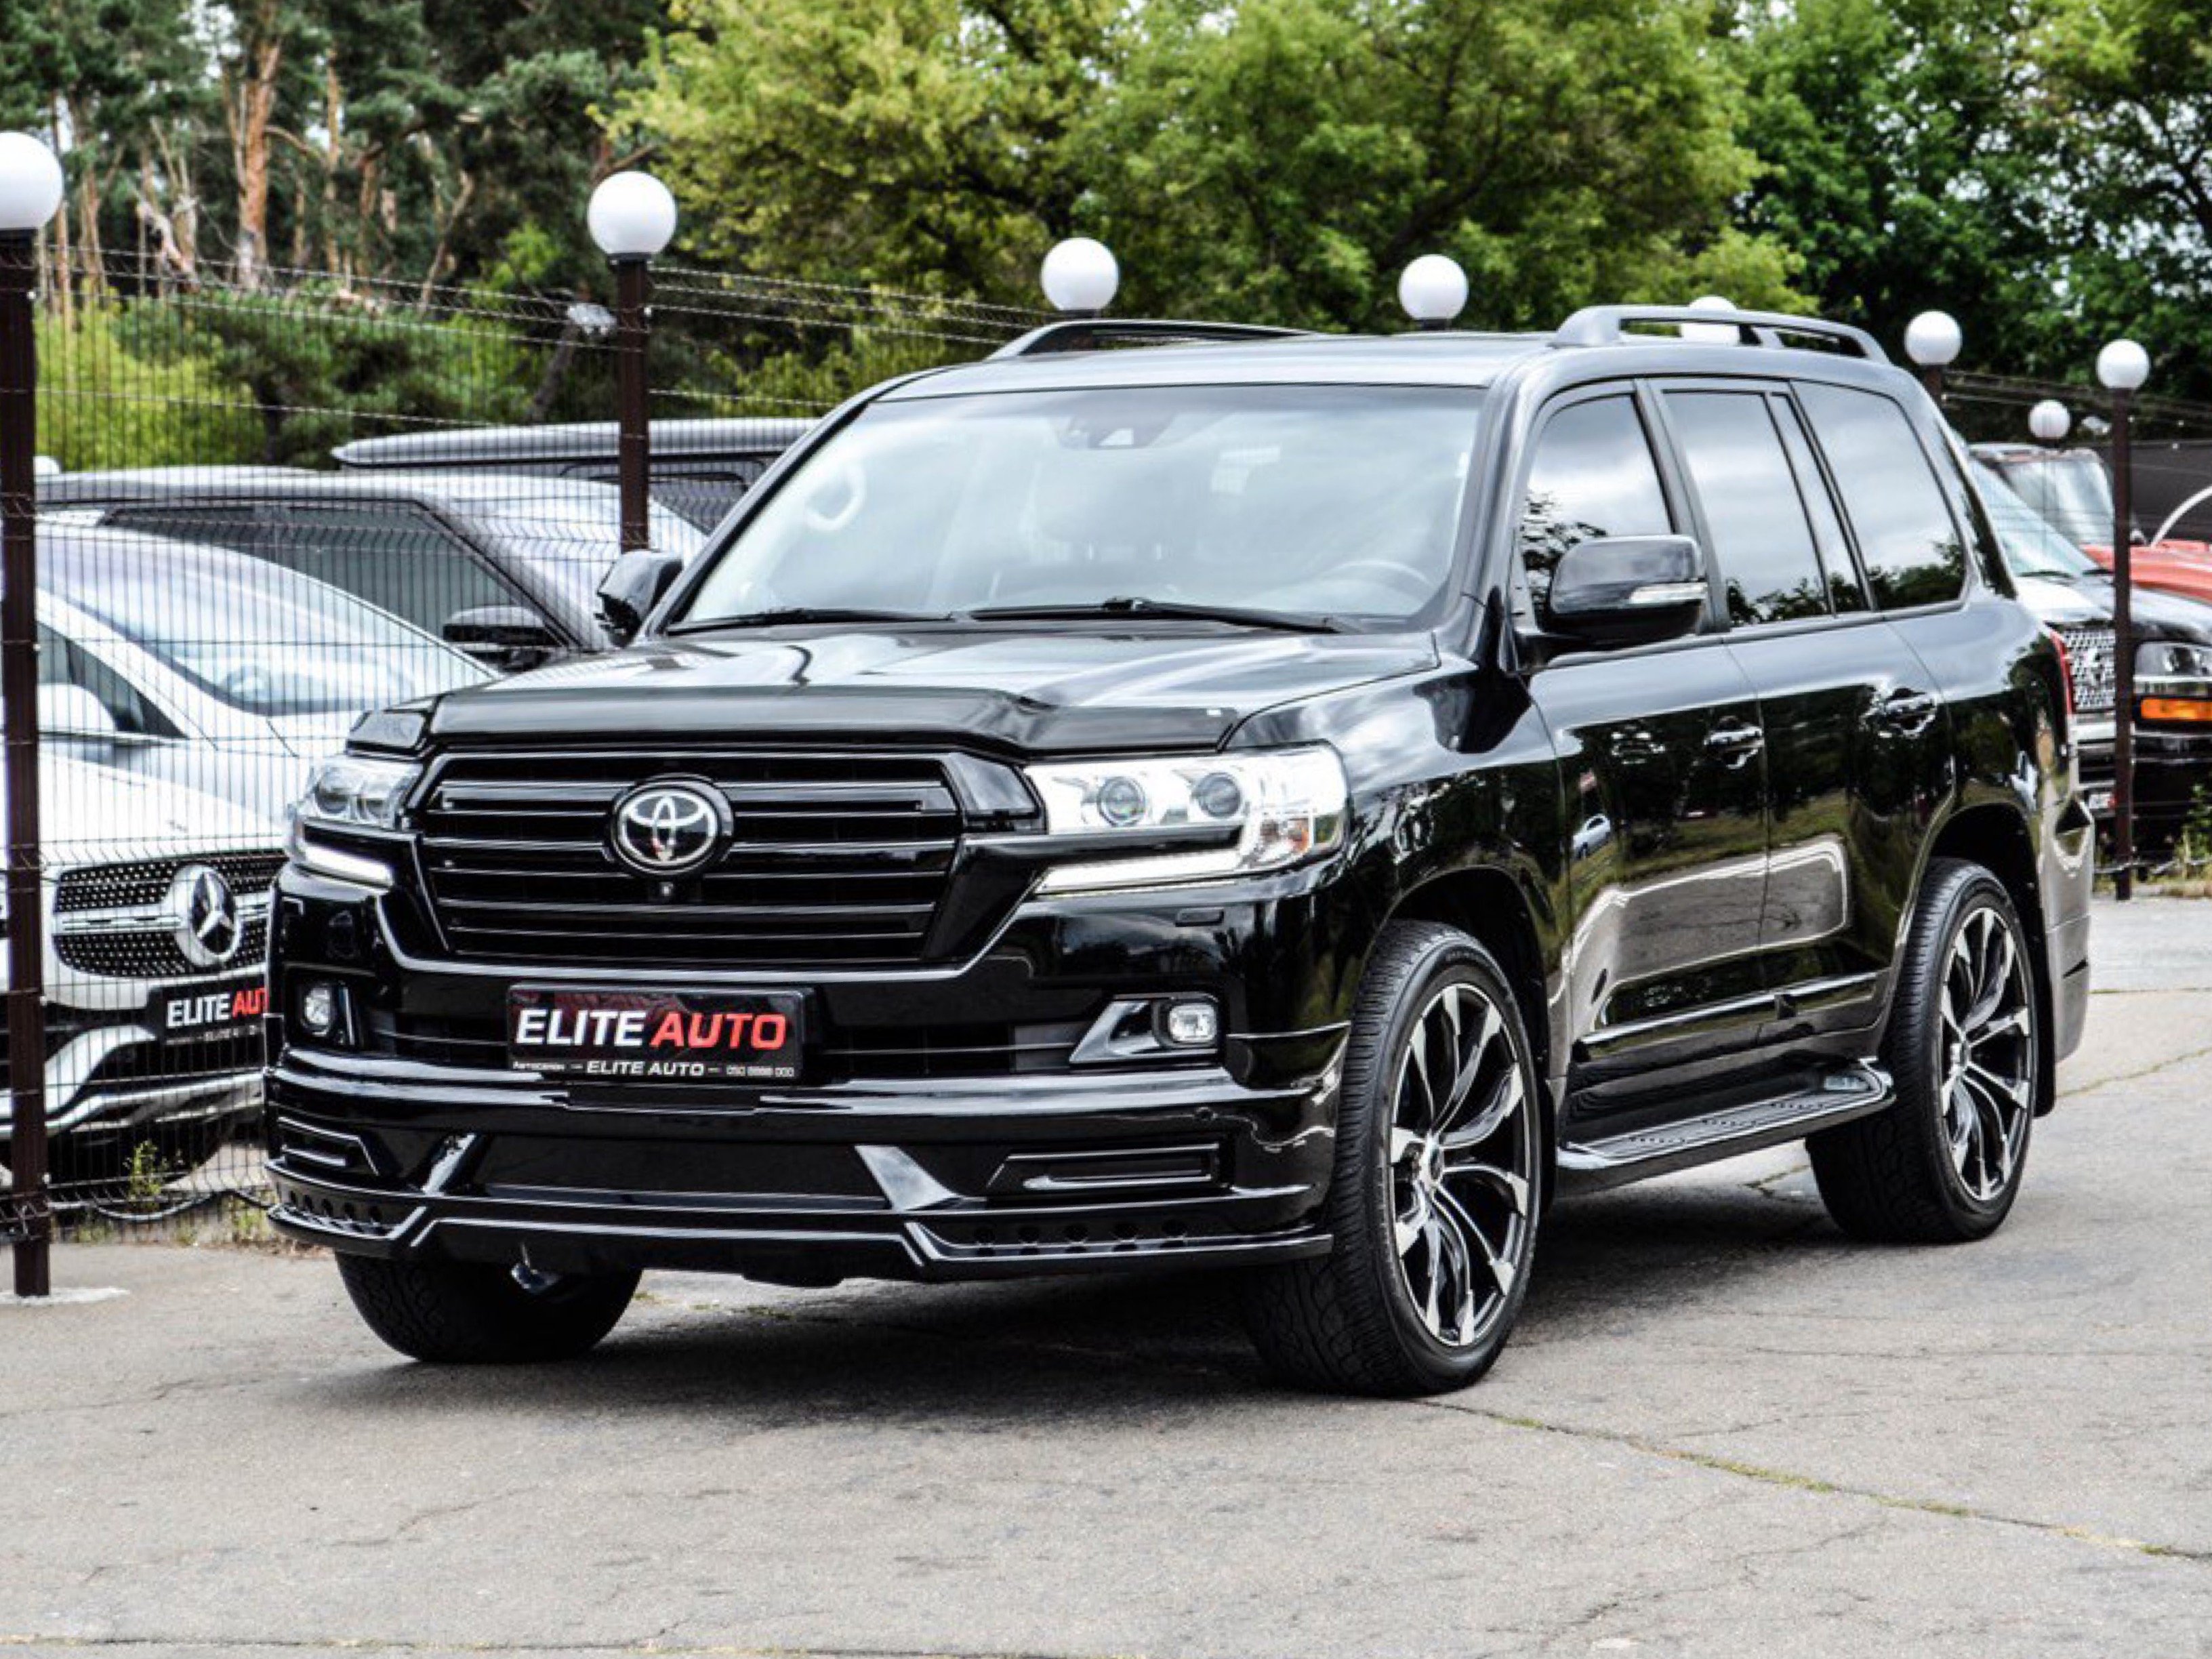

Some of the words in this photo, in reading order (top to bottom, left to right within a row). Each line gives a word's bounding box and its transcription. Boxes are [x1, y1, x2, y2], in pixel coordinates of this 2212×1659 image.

[166, 993, 230, 1029] ELITE
[515, 1008, 647, 1047] ELITE
[649, 1011, 787, 1049] AUTO
[587, 1060, 645, 1076] ELITE
[647, 1061, 704, 1076] AUTO
